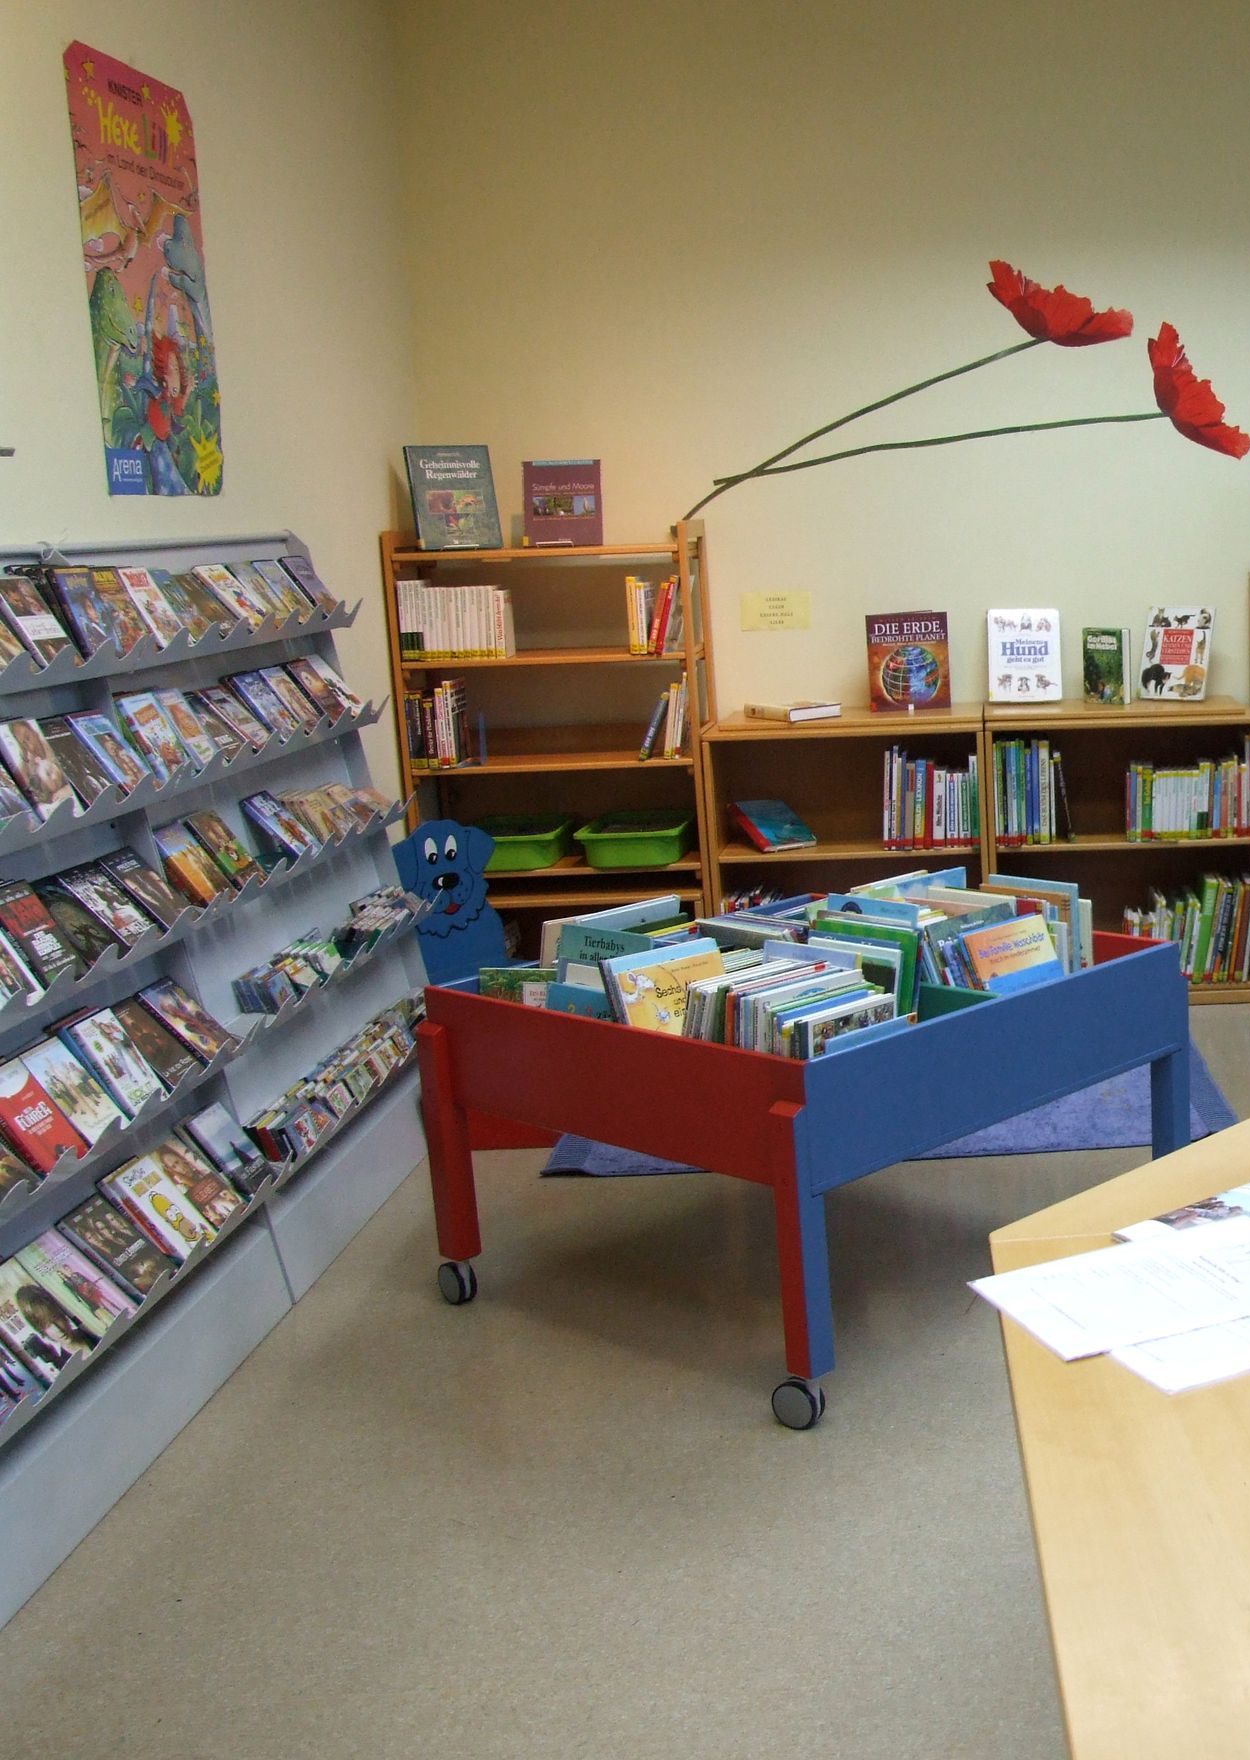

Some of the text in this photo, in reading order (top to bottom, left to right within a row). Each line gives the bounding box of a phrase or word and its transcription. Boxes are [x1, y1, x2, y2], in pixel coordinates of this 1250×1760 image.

[108, 79, 143, 106] KNISTER
[113, 458, 143, 481] Arena
[420, 459, 480, 469] Geheimnisvolle
[426, 469, 477, 480] Regenwälder
[874, 620, 943, 635] DIE ERDE,
[871, 634, 915, 644] BEDROHTE
[915, 633, 946, 642] PLANET
[1163, 634, 1192, 643] KATZEN
[1001, 641, 1049, 656] Hund
[1032, 656, 1045, 664] gut
[584, 935, 625, 953] Tierbabys
[579, 950, 588, 960] in
[656, 984, 682, 999] Sechs
